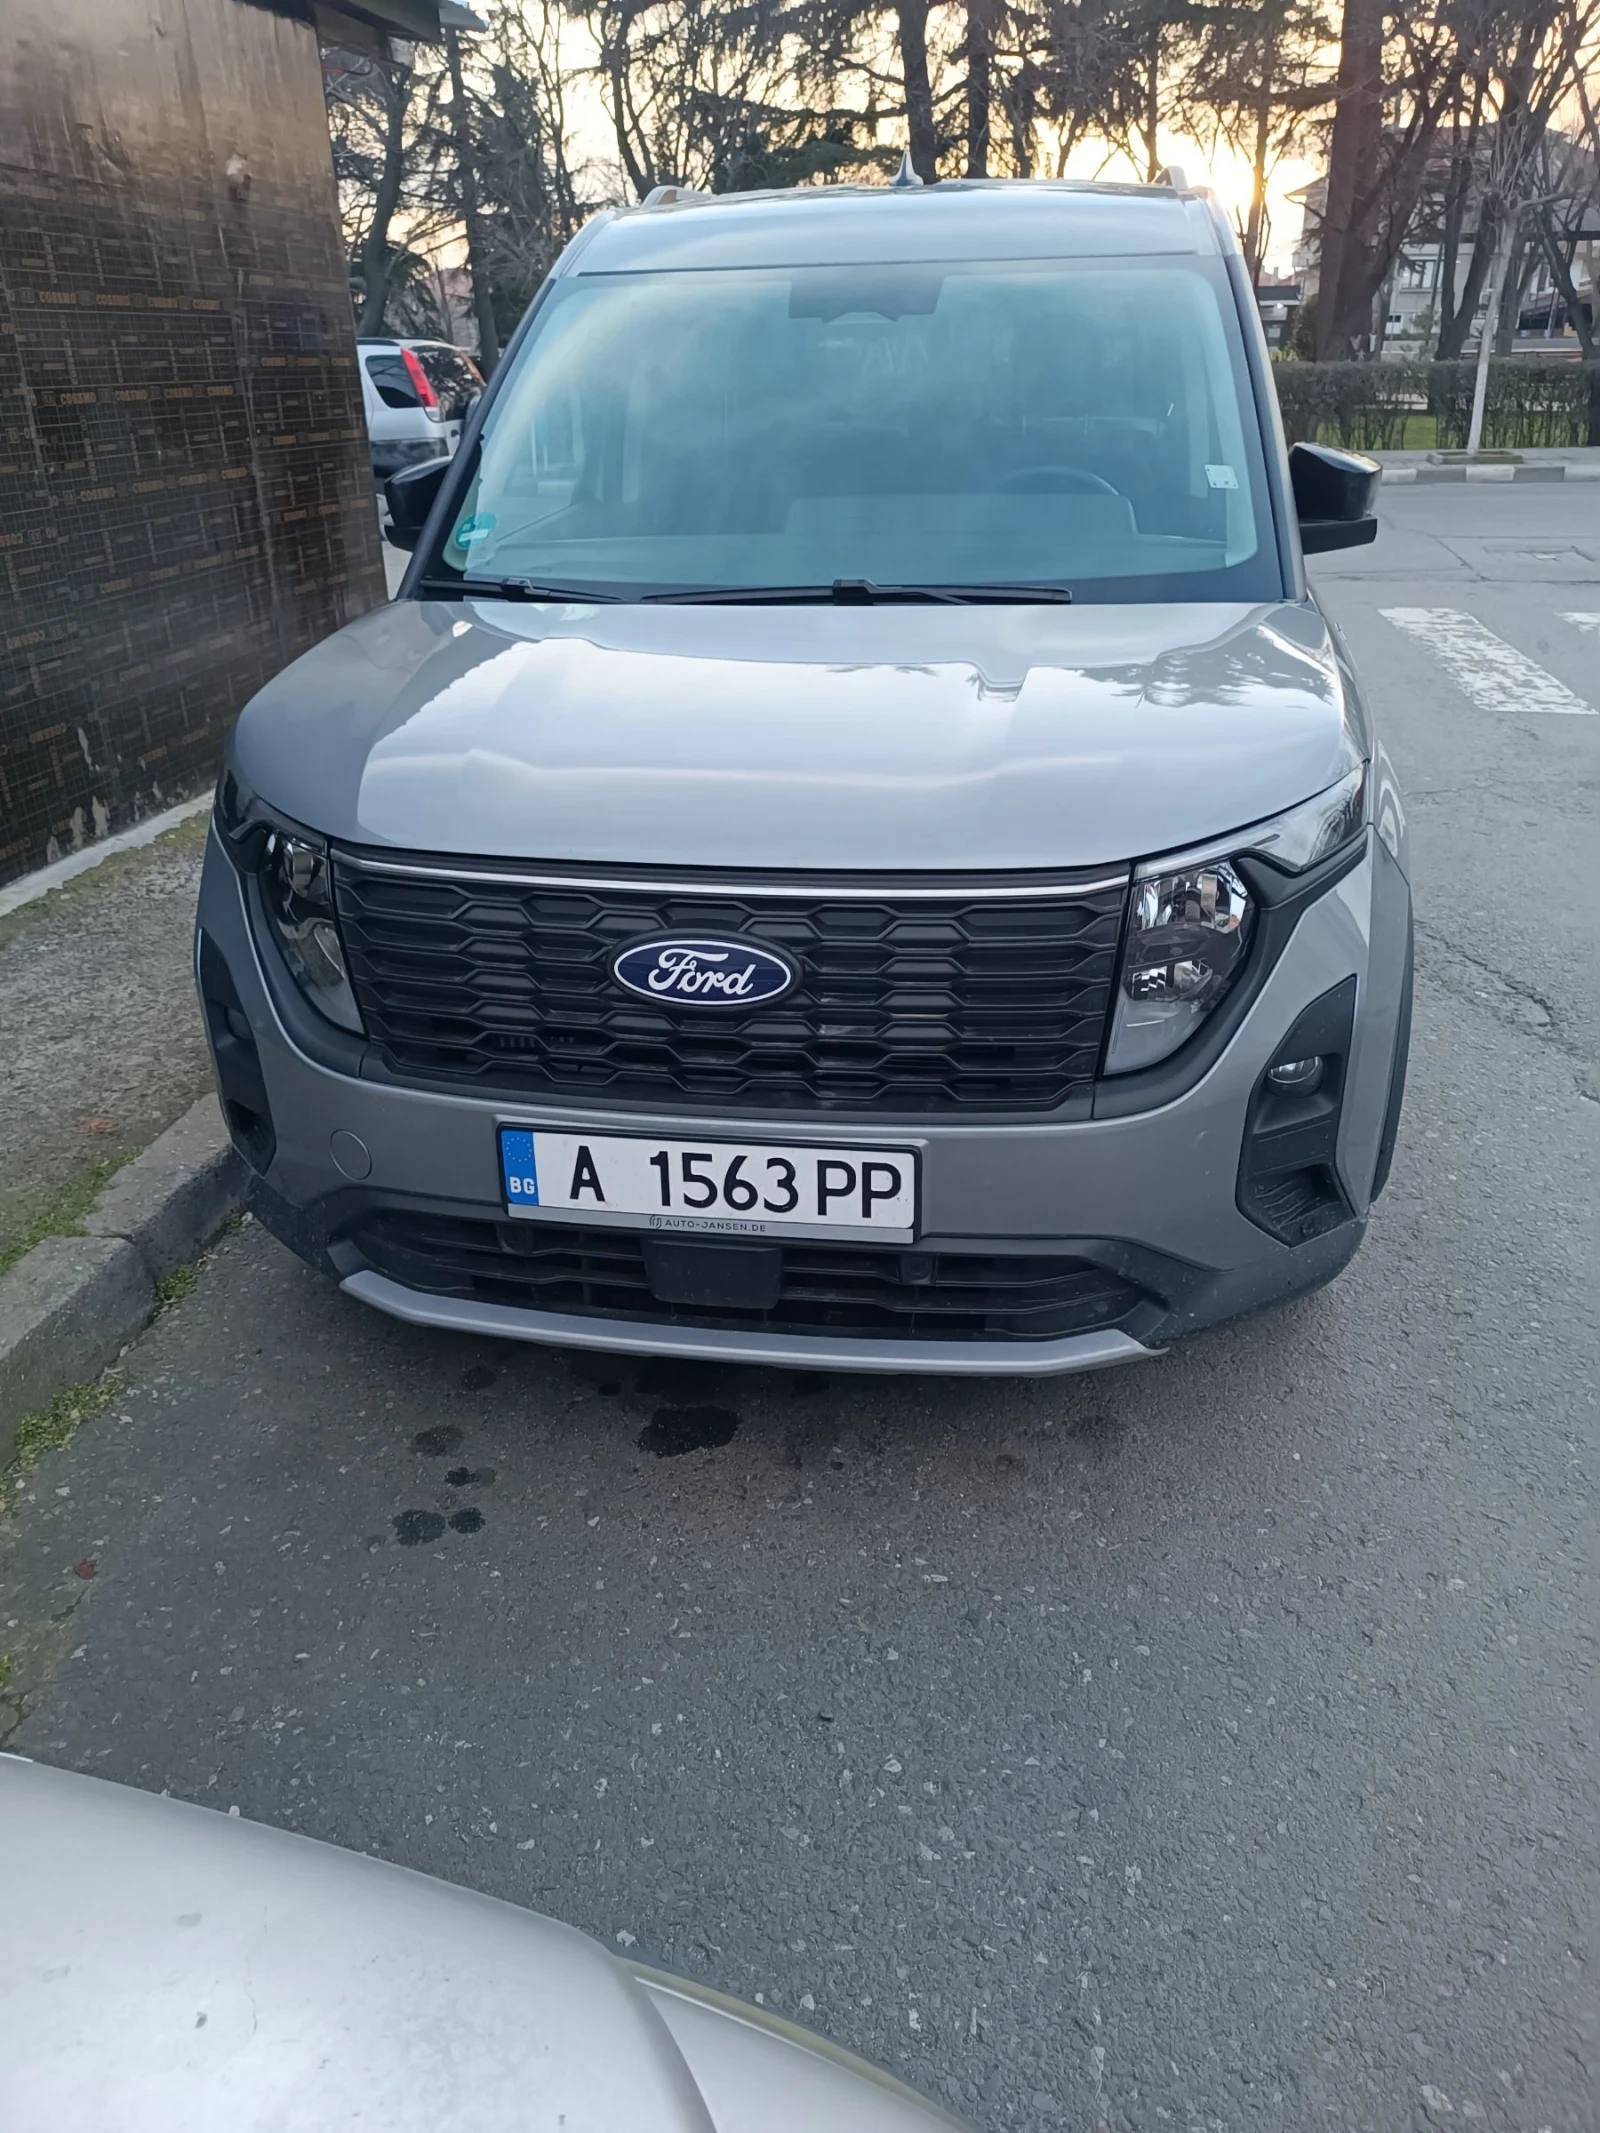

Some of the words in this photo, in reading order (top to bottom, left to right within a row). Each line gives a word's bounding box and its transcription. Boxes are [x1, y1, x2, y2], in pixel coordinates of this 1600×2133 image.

[648, 948, 756, 995] Ford
[510, 1176, 535, 1194] BG
[569, 1145, 607, 1202] A
[649, 1150, 799, 1213] 1563
[816, 1159, 902, 1218] PP
[665, 1219, 766, 1232] AUTO-JANSEN.DE
